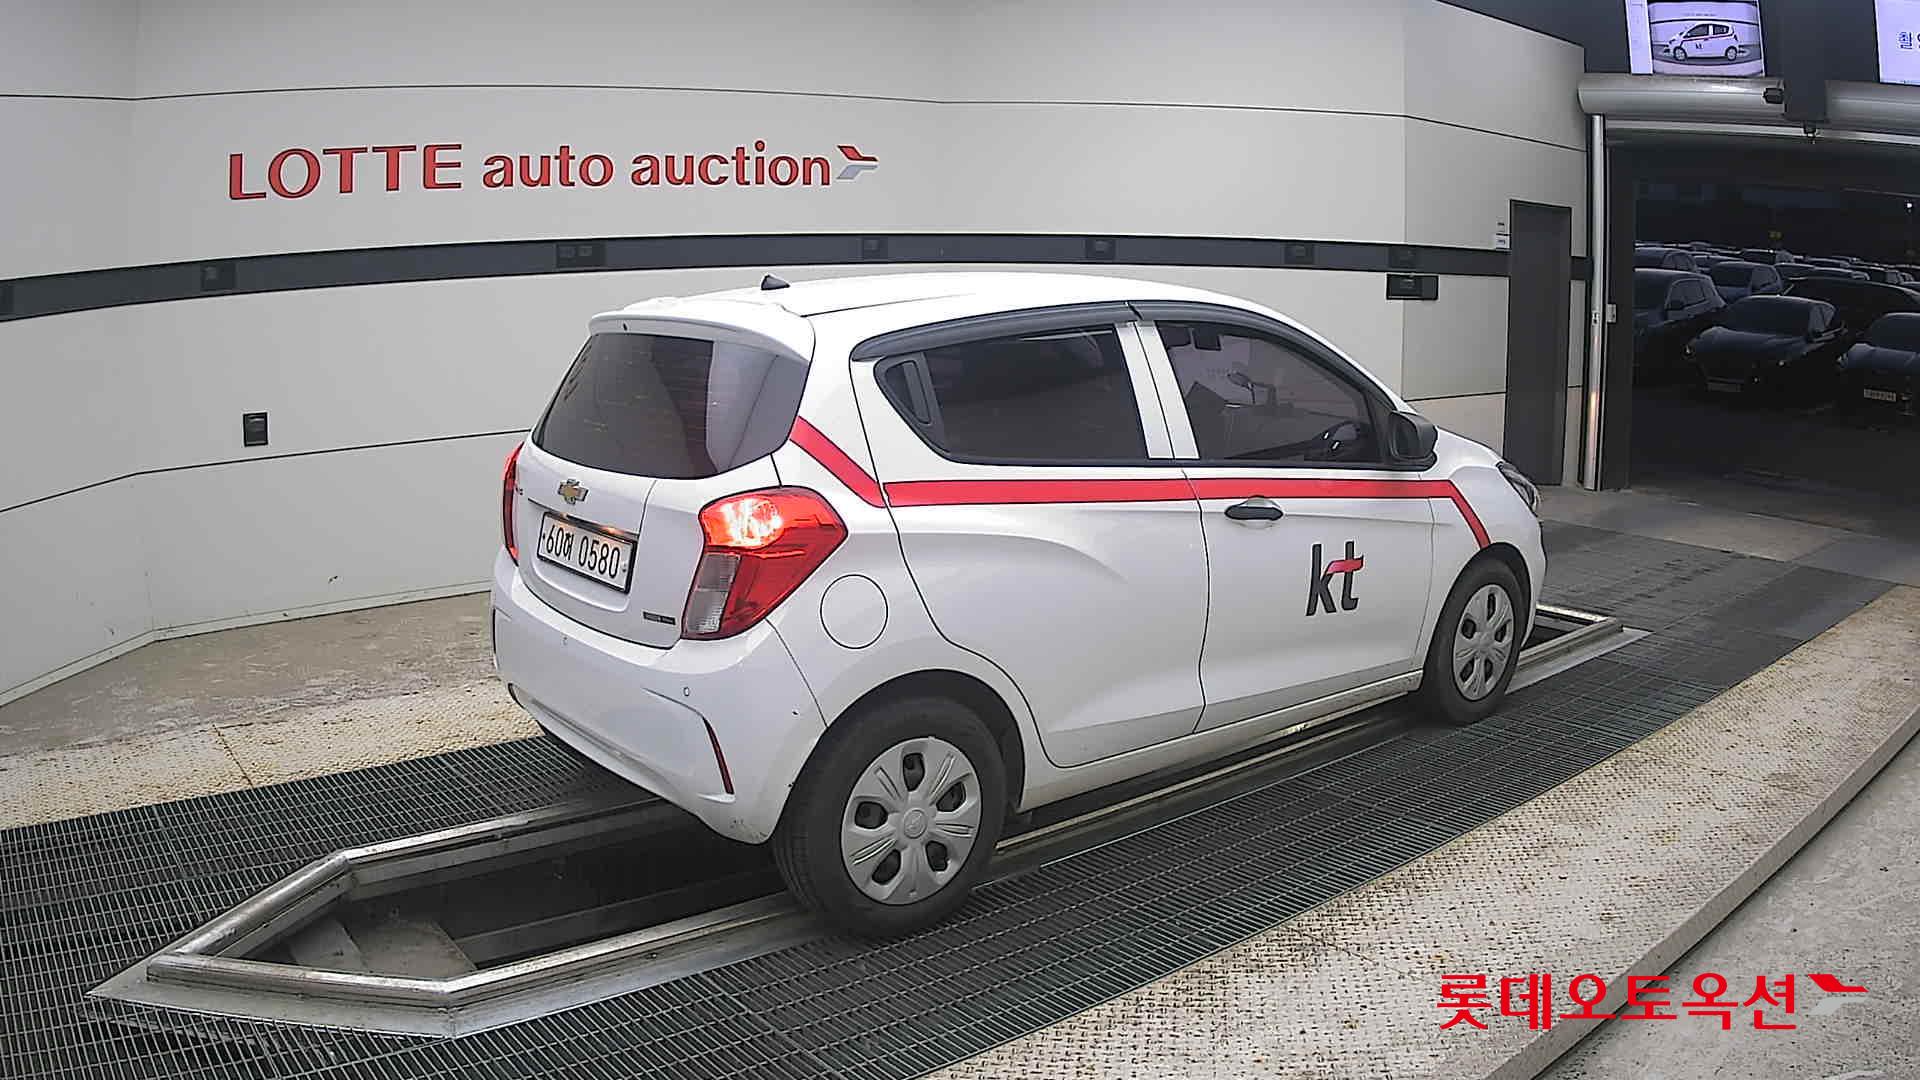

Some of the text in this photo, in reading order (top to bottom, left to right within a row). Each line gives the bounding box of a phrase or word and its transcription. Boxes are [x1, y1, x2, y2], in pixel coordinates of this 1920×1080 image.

[228, 140, 831, 201] LOTTE auto auction
[578, 535, 621, 579] 0580
[1306, 541, 1364, 616] kt
